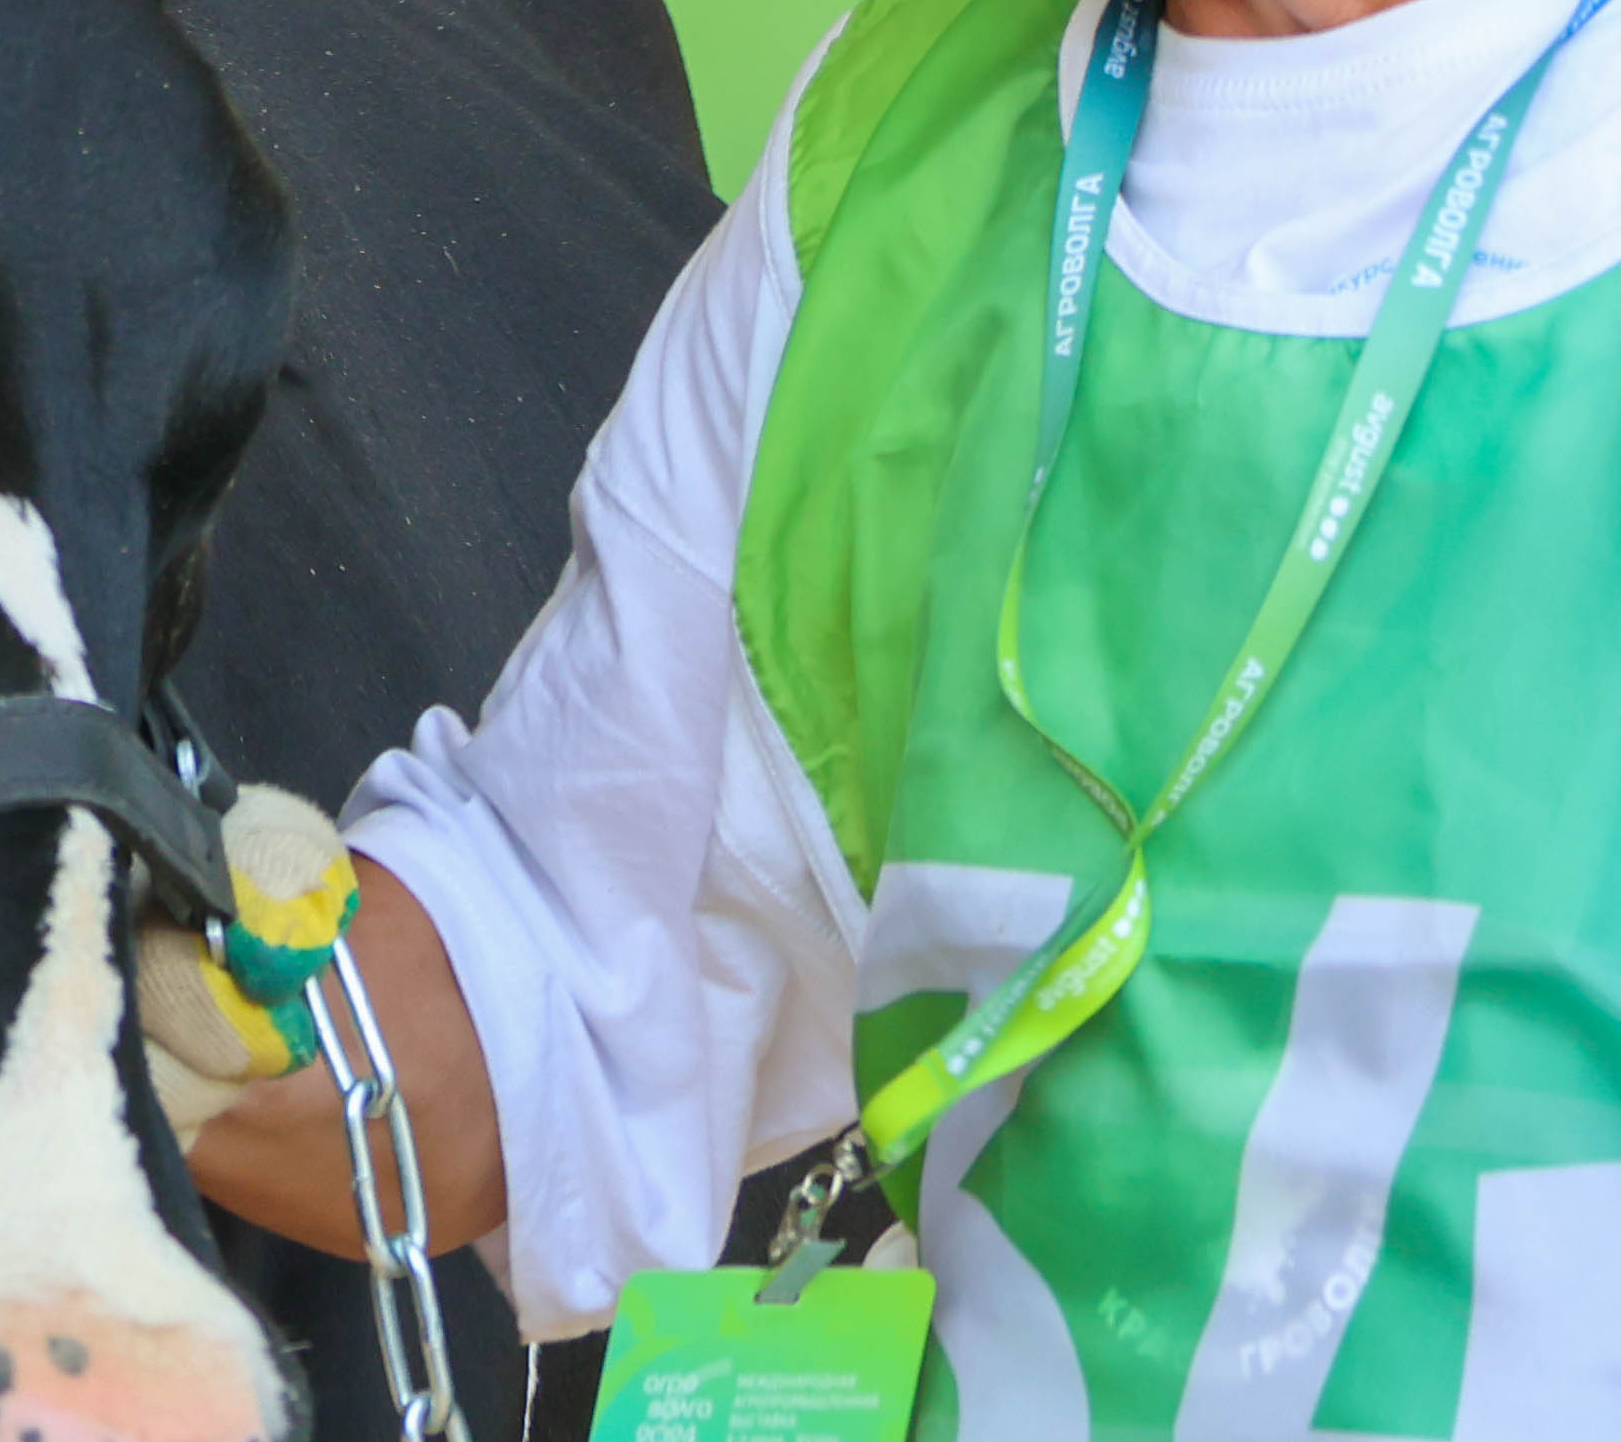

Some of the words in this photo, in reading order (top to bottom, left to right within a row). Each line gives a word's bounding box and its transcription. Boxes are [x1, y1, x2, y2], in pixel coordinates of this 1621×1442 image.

[1103, 1, 1140, 80] avgust
[1053, 170, 1105, 358] АГРОВОЛГА
[1410, 111, 1509, 289] АГРОВОЛГА
[1338, 390, 1396, 494] avgust
